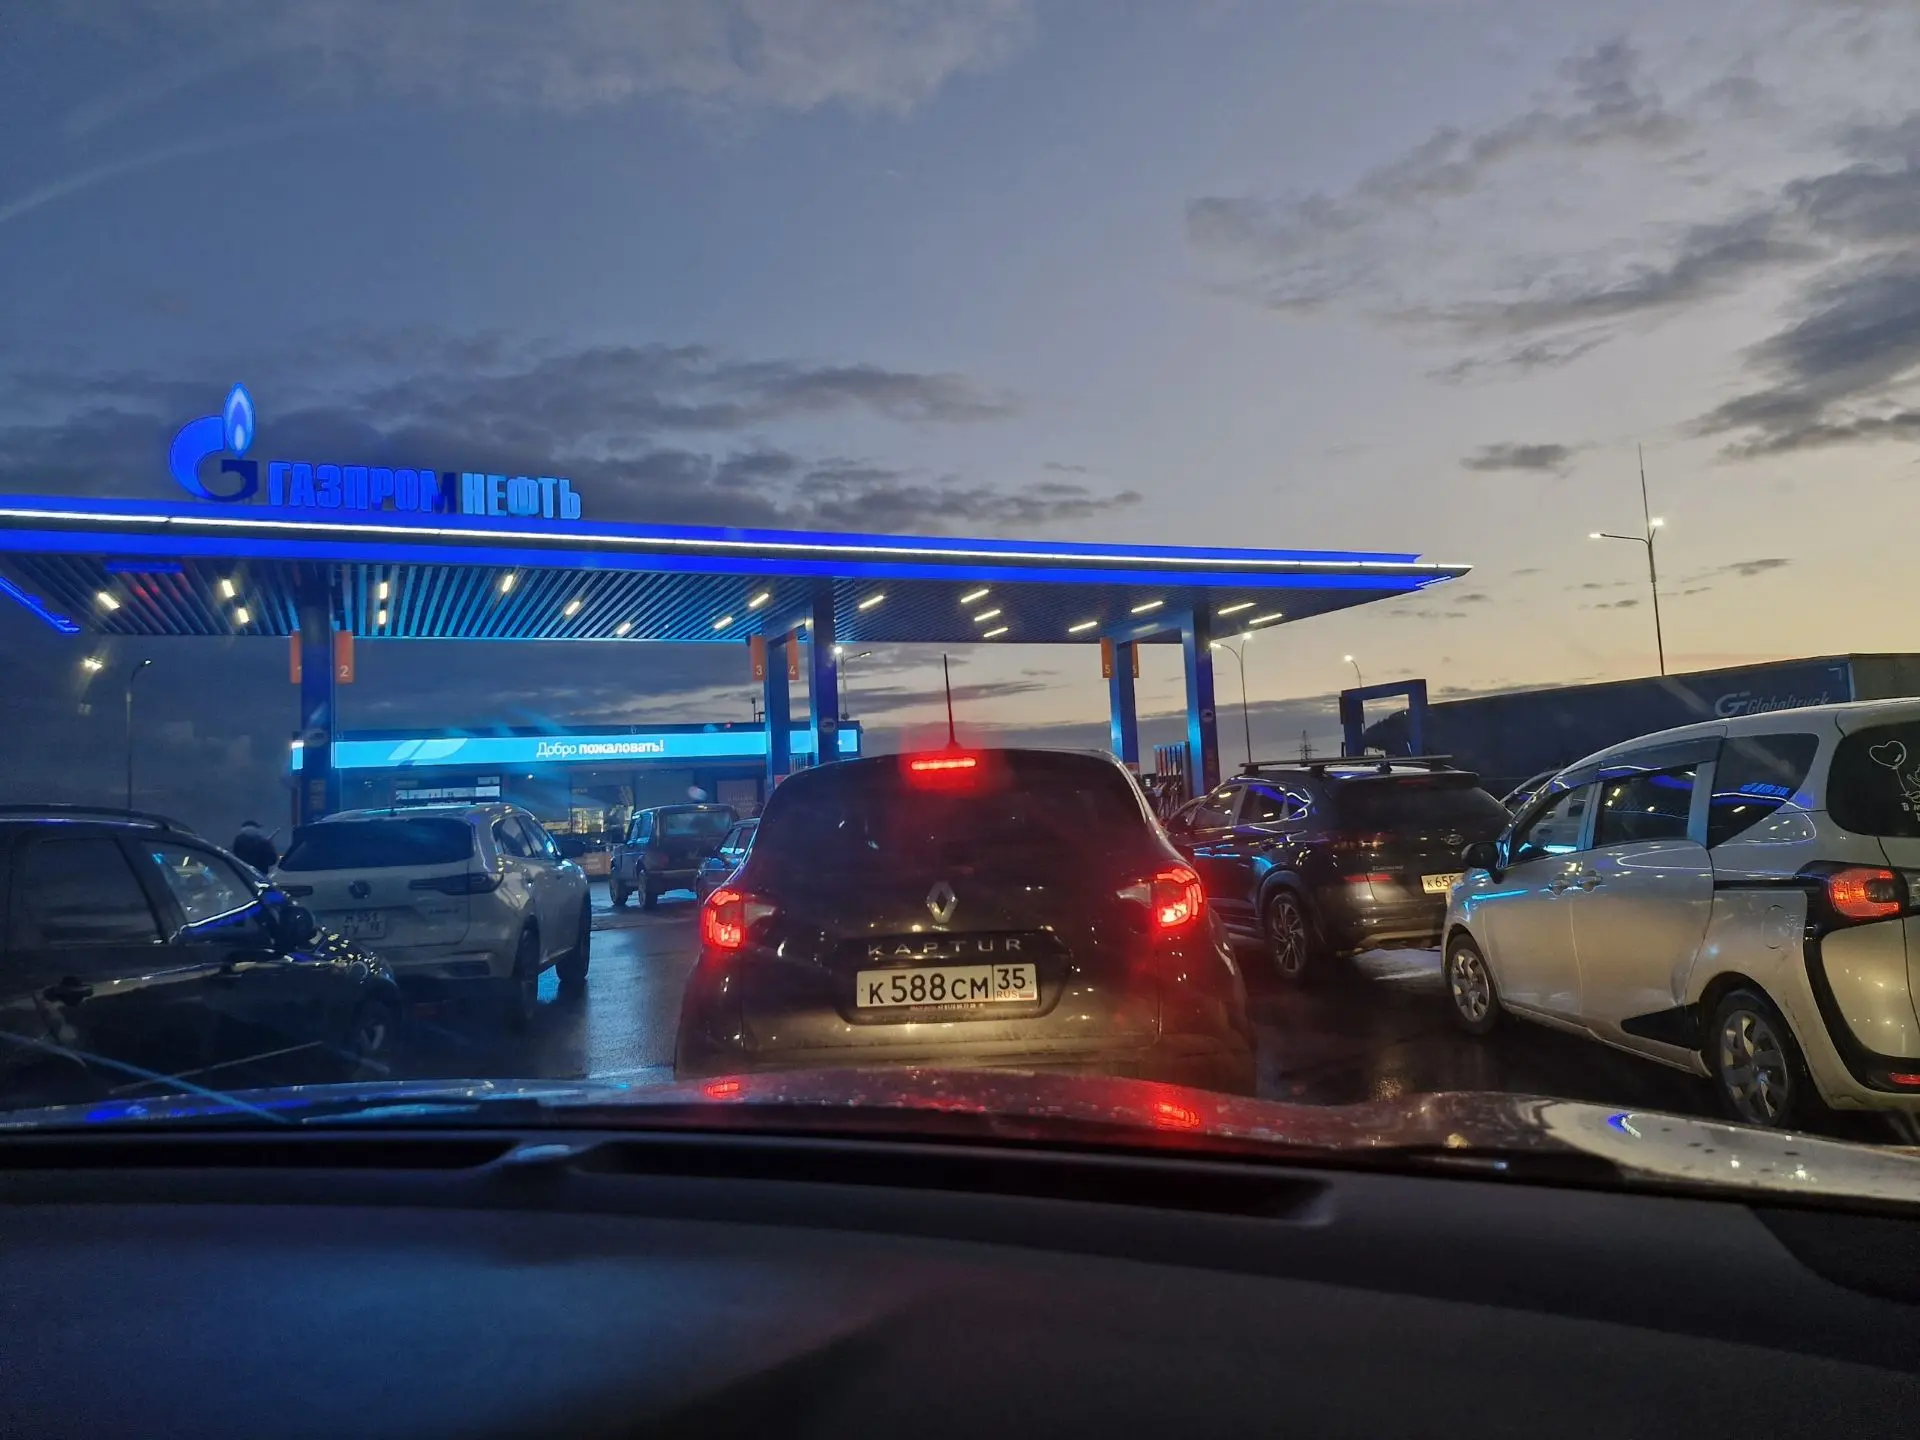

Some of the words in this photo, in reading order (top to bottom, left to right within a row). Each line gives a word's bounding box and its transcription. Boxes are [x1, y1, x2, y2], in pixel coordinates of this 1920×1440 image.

[340, 665, 349, 677] 2
[756, 665, 762, 676] 3
[789, 665, 796, 675] 4
[1746, 691, 1830, 714] Globaltruck
[536, 741, 576, 758] Добро
[579, 739, 665, 755] пожаловать!
[868, 938, 1022, 956] KAPTUR
[869, 973, 989, 1004] К588СМ
[997, 968, 1026, 990] 35
[996, 990, 1018, 999] RUS
